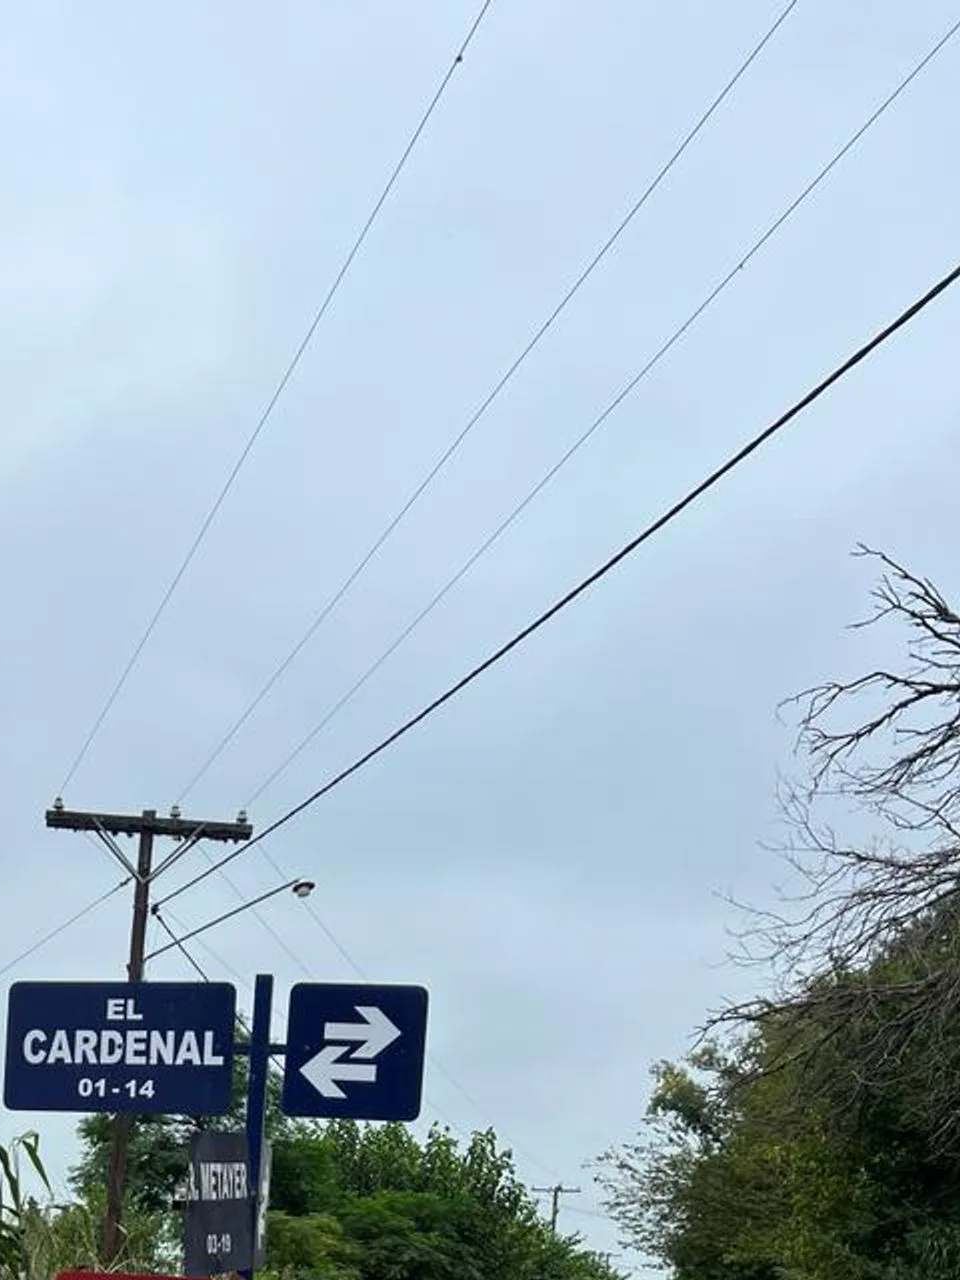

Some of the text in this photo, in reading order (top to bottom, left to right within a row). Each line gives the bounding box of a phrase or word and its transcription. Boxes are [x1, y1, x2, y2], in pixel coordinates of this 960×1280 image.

[106, 998, 143, 1020] EL
[23, 1028, 225, 1066] CARDENAL
[78, 1077, 155, 1099] 01-14
[200, 1161, 248, 1201] METAYER
